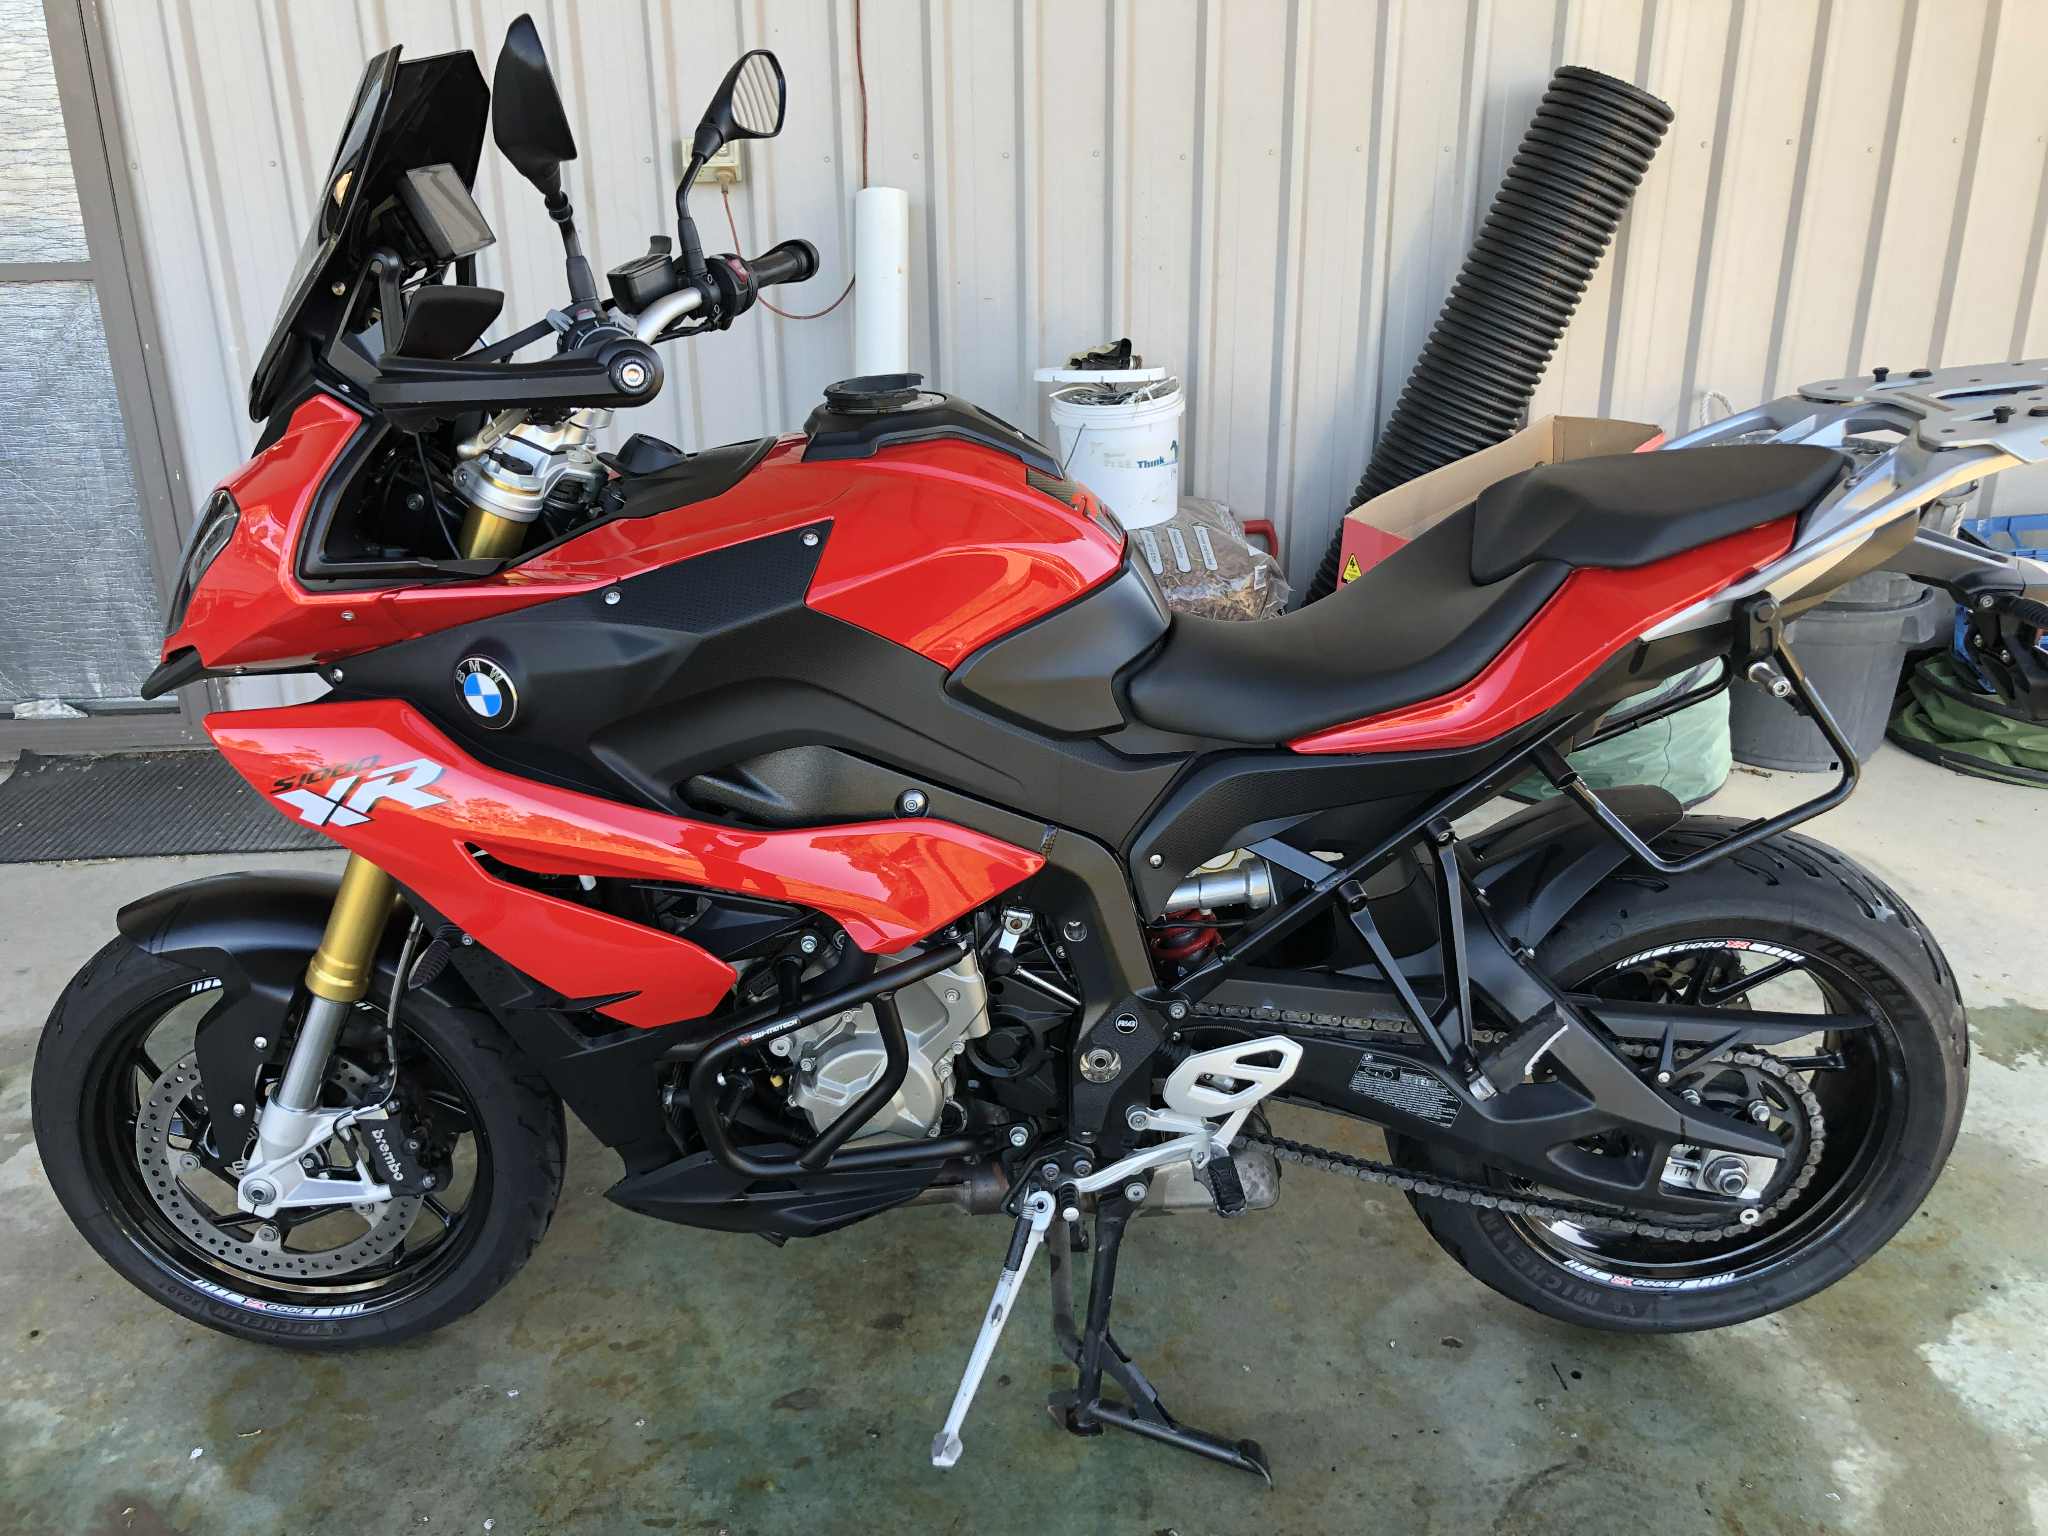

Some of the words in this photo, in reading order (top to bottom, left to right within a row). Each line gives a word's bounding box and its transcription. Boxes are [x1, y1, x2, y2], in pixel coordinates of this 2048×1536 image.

[455, 660, 504, 685] BMW
[273, 757, 449, 828] XR
[371, 1128, 404, 1181] brembo
